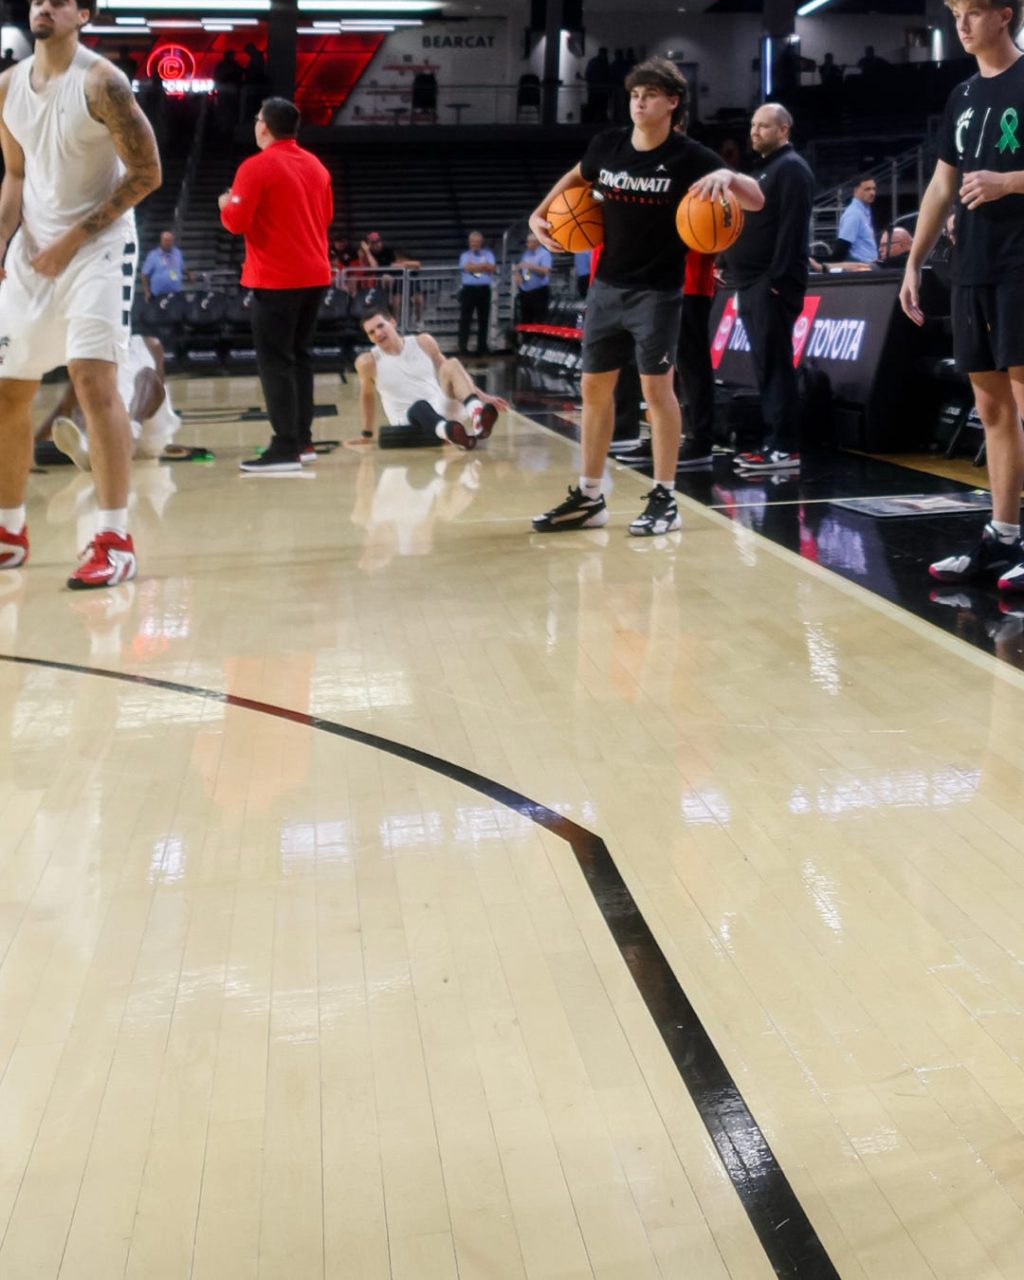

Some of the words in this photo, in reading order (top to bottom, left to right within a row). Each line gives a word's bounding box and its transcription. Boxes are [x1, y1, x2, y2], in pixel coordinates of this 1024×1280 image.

[422, 36, 495, 48] BEARCAT
[599, 169, 671, 193] CINCINNATI
[806, 319, 865, 360] TOYOTA
